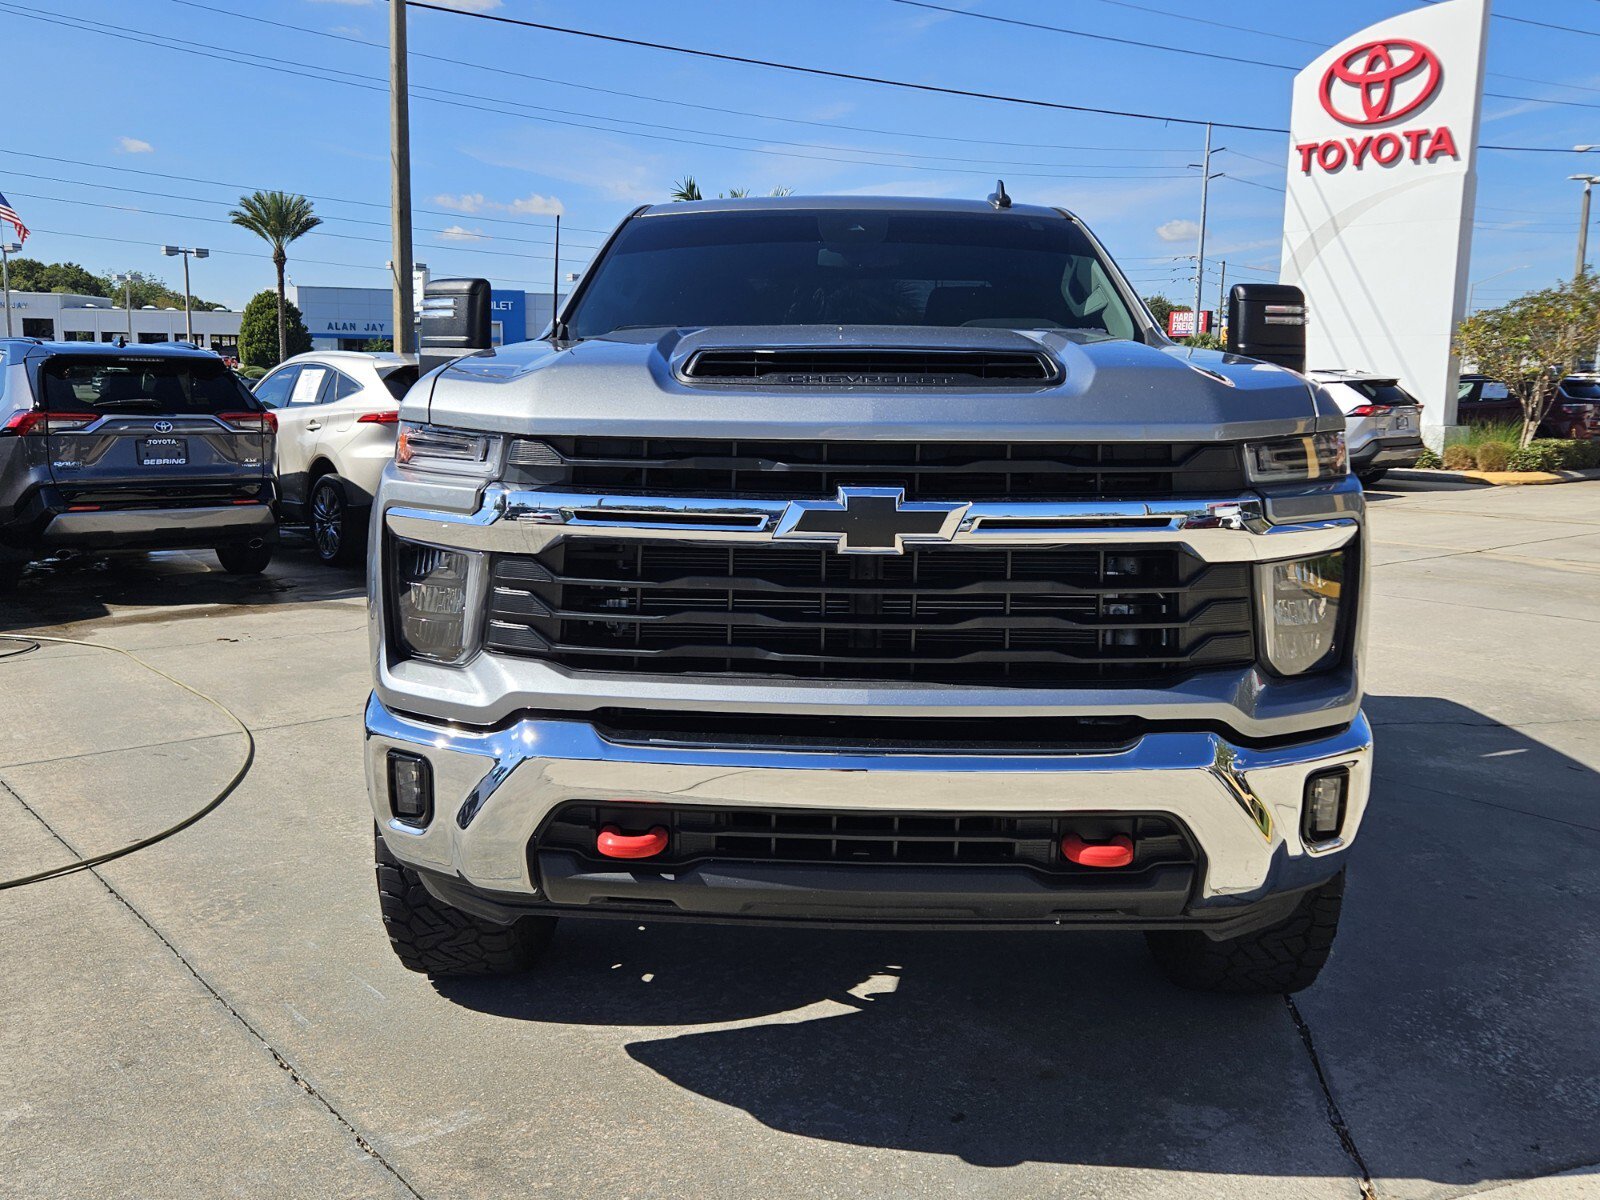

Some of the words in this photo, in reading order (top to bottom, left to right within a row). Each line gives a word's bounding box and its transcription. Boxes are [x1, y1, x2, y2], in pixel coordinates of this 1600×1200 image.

[1295, 125, 1458, 173] TOYOTA
[1172, 312, 1204, 322] HARBR
[327, 321, 357, 331] ALAN
[363, 322, 385, 332] JAY
[1172, 321, 1204, 331] FREIGT
[787, 374, 956, 384] CHEVROLET
